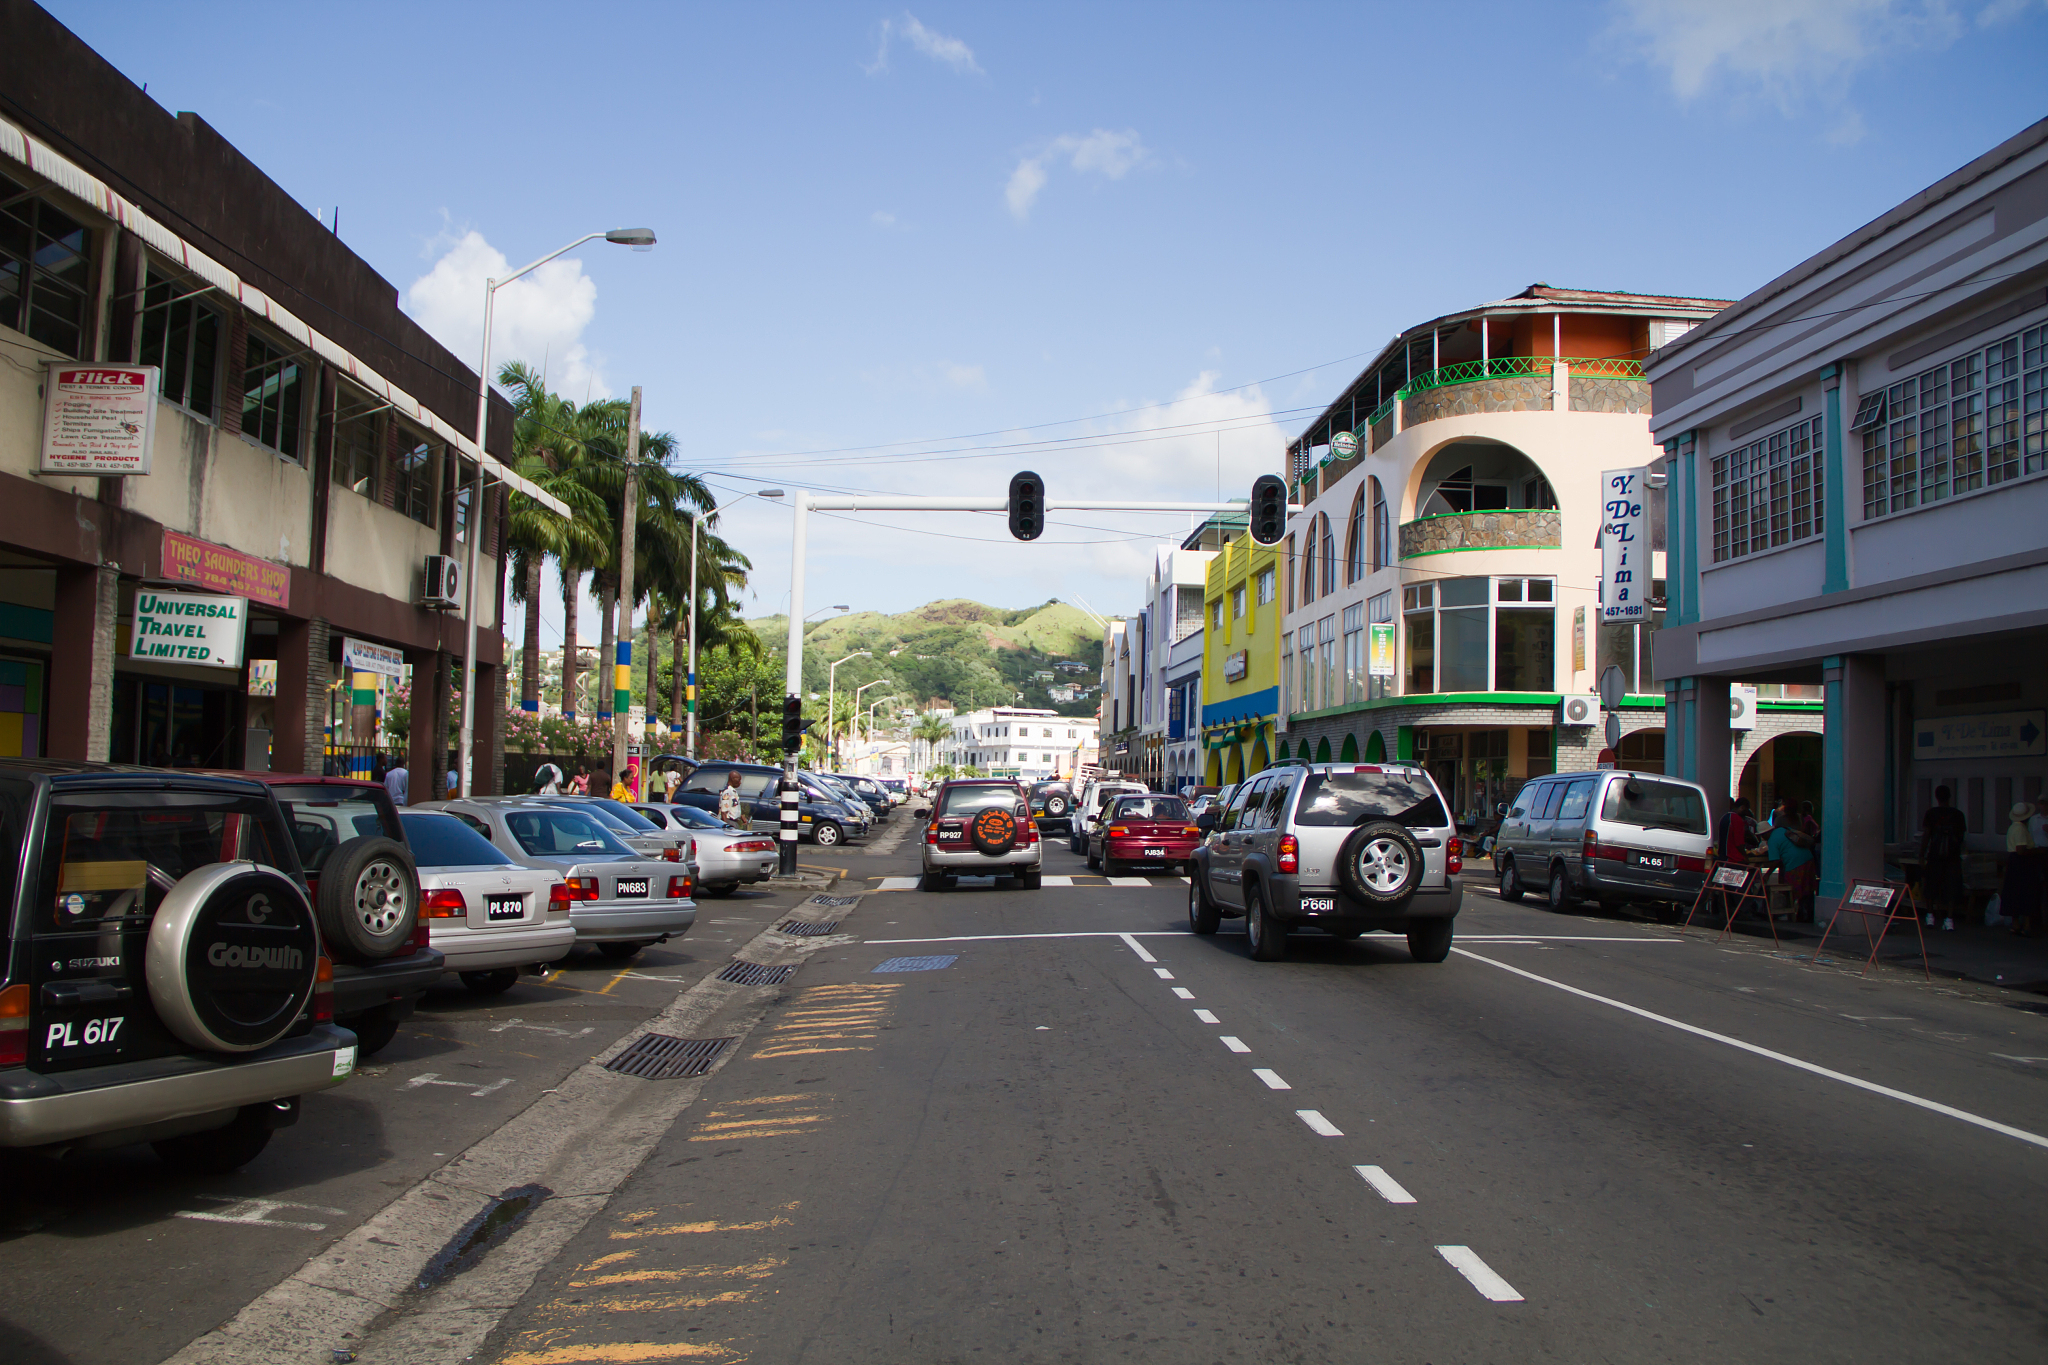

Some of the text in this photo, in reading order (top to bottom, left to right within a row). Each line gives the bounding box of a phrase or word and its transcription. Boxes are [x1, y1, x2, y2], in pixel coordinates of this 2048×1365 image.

[73, 372, 133, 384] Flick
[1606, 474, 1642, 600] Y. De Lima
[170, 540, 286, 588] THEO SAUNDERS SHOP
[204, 572, 228, 585] 784
[230, 578, 280, 599] 457-1914
[1605, 606, 1642, 616] 457-1681
[1640, 857, 1662, 867] PL 65
[618, 882, 646, 893] PN683
[490, 900, 522, 914] PL 870
[68, 956, 120, 968] SUZUKI
[46, 1016, 124, 1048] PL 617
